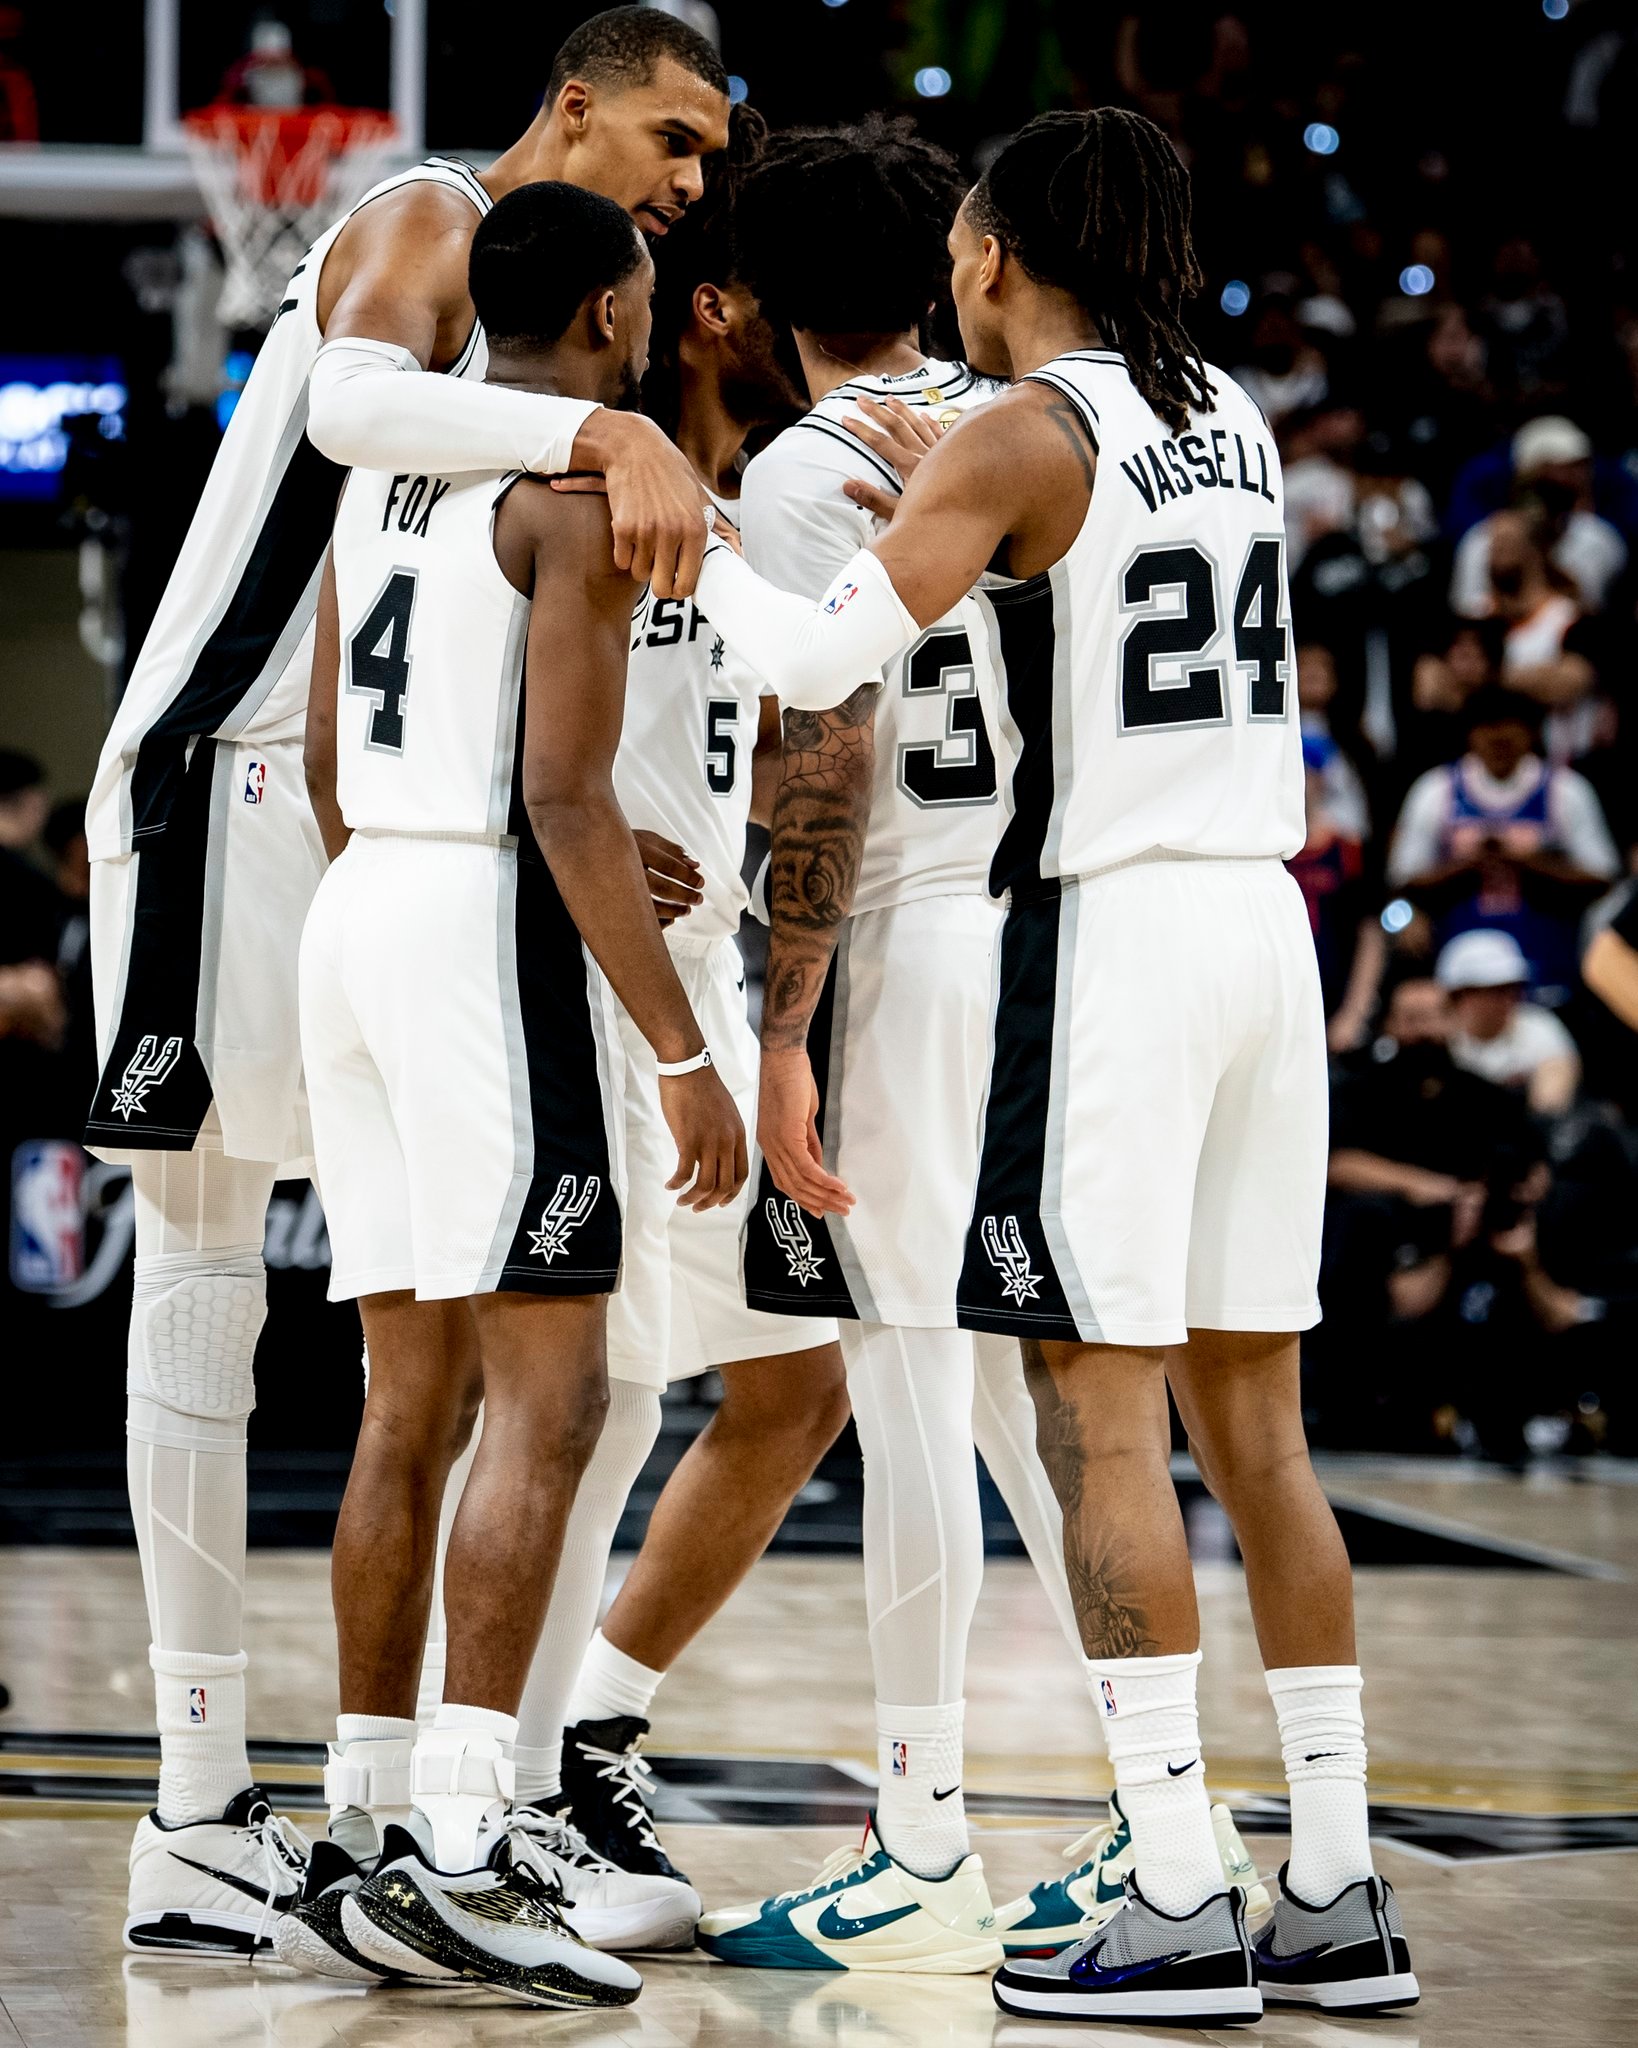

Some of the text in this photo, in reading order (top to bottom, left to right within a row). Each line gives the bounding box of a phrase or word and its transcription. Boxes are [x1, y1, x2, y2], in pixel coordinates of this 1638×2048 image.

[381, 473, 451, 538] FOX
[1119, 429, 1275, 514] VASSELL
[344, 564, 420, 759] 4
[1116, 532, 1292, 738] 24
[704, 697, 740, 798] 5
